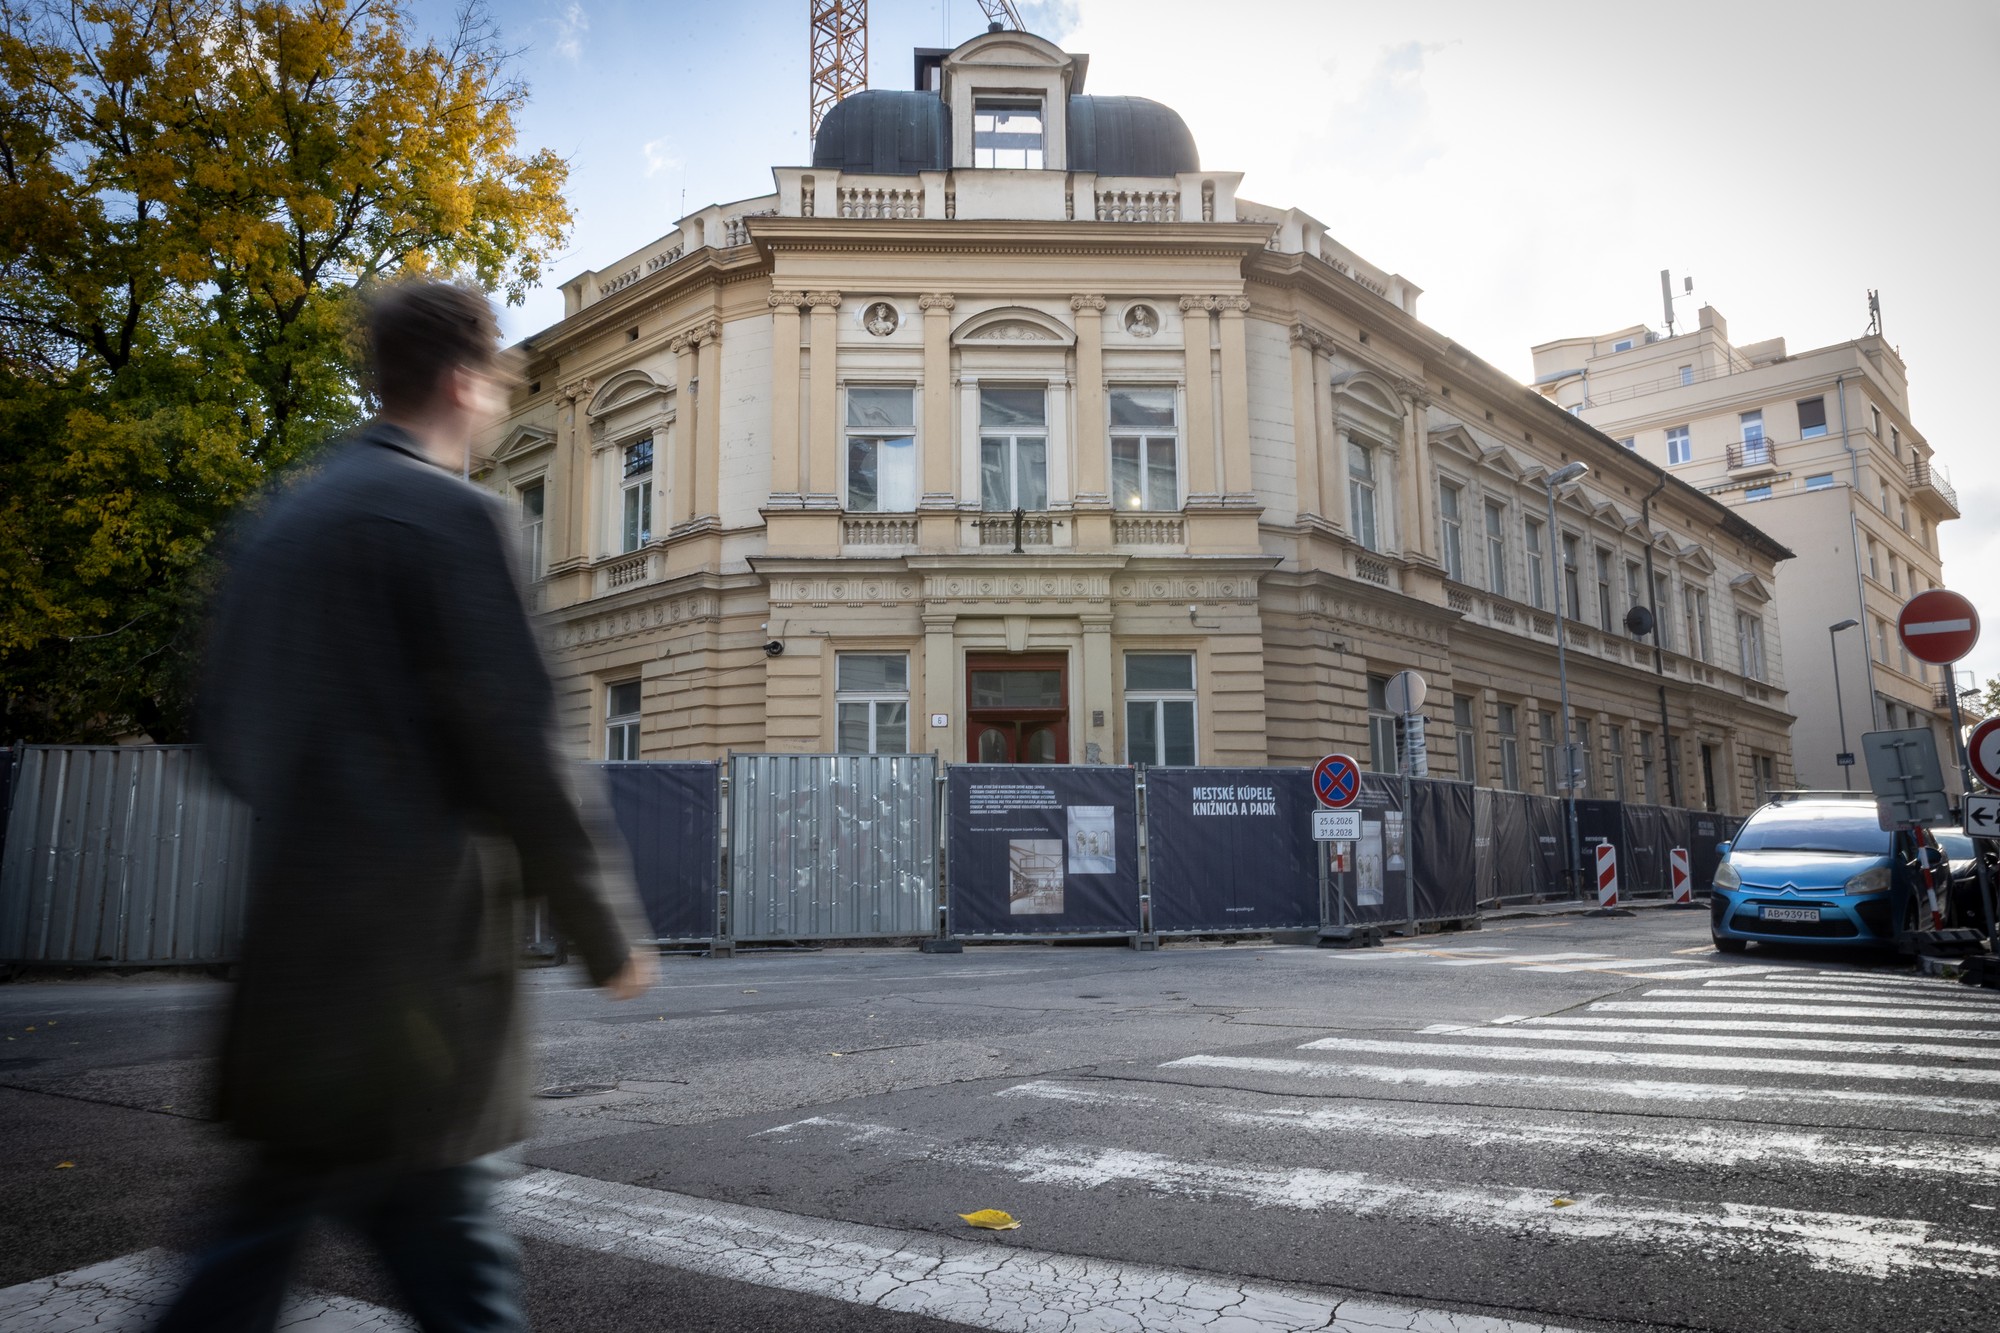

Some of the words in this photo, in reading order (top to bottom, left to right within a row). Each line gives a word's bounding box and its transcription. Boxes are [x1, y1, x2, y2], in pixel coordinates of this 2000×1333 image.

[1193, 785, 1235, 800] MESTSKÉ
[1237, 785, 1275, 801] KÚPELE,
[1193, 800, 1238, 816] KNIŽNICA
[1241, 802, 1247, 816] A
[1250, 802, 1276, 816] PARK
[1320, 817, 1353, 825] 25.6.2026
